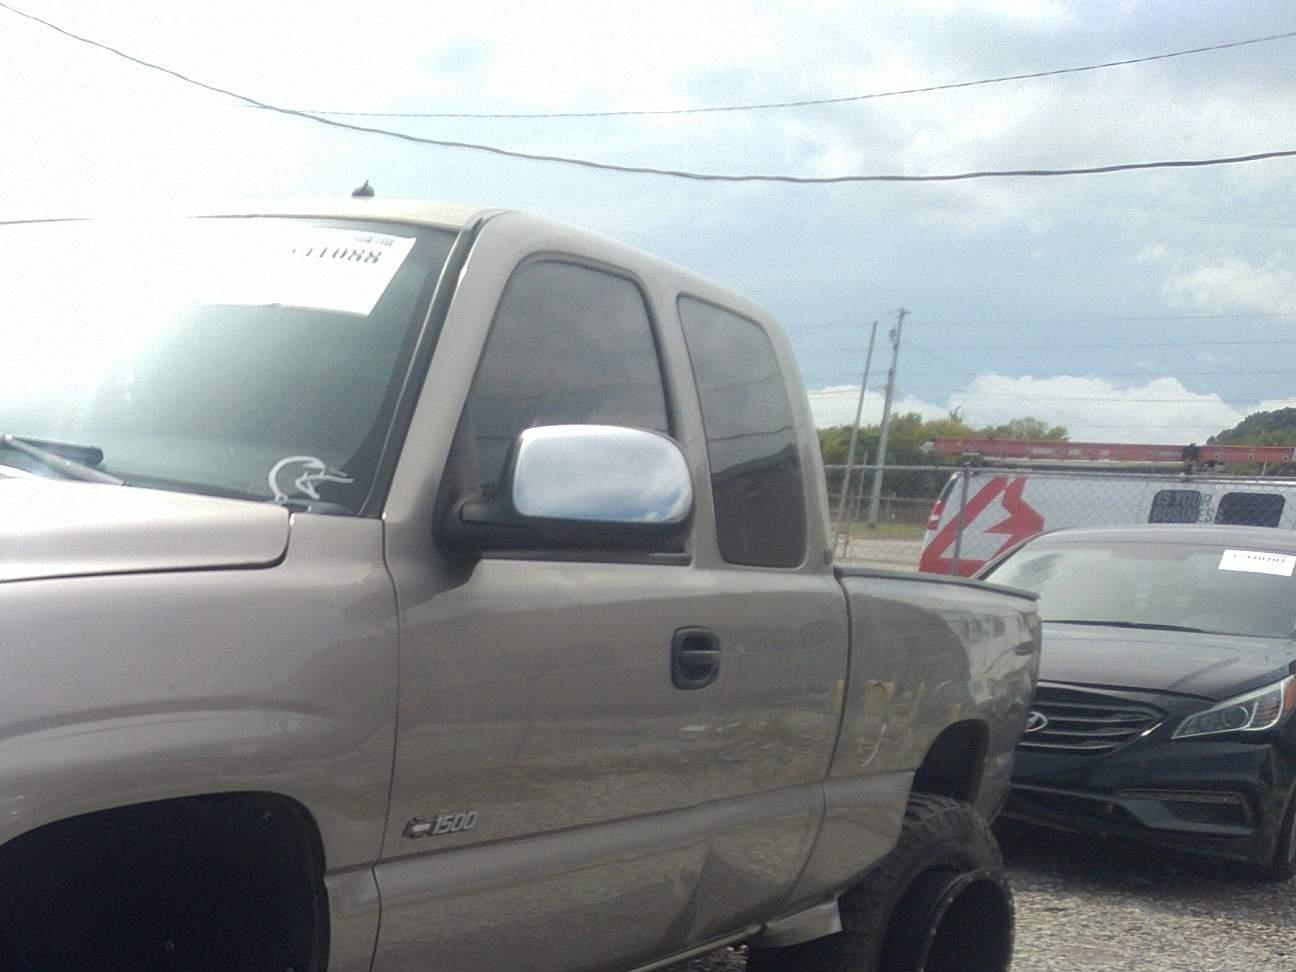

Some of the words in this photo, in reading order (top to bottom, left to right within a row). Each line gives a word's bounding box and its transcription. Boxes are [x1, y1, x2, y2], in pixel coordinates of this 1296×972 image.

[1157, 491, 1172, 505] IS
[1173, 492, 1214, 507] YOUR
[1153, 504, 1226, 524] BUSINESS
[432, 811, 480, 835] 1500
